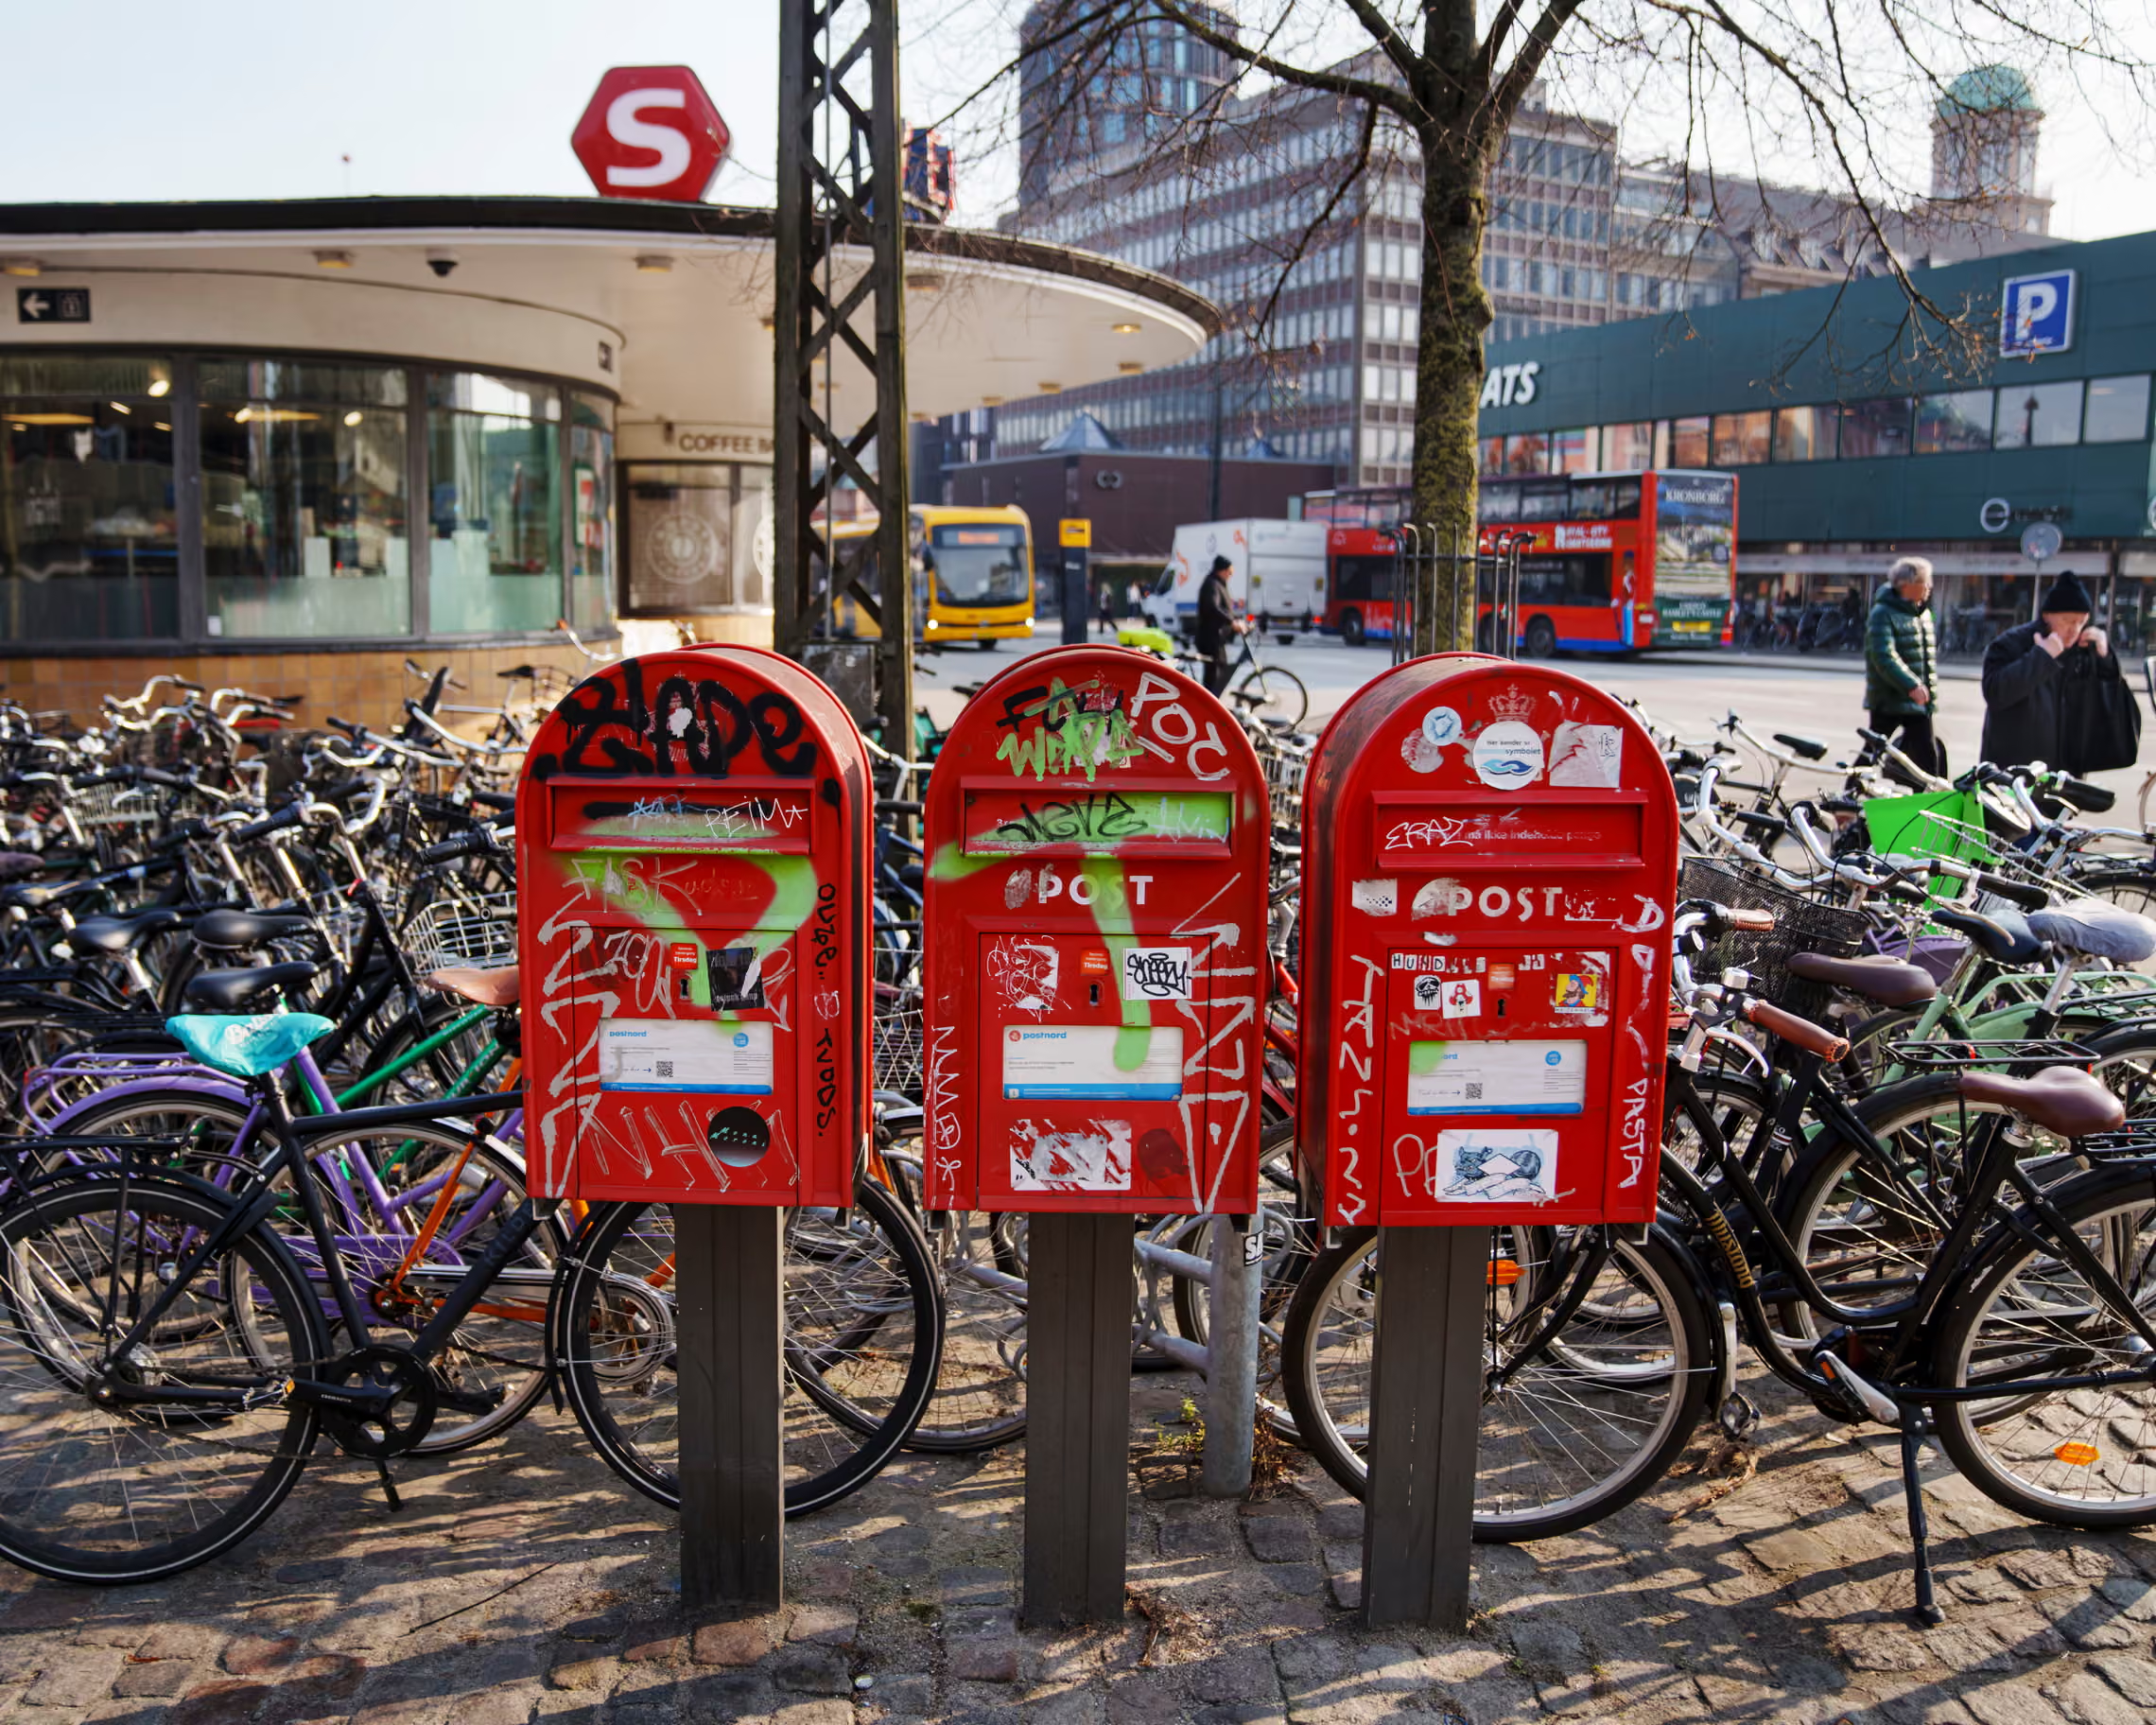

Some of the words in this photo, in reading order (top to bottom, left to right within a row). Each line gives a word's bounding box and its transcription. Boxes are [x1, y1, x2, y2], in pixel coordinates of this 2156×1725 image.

[606, 87, 691, 187] S
[2015, 283, 2058, 340] P
[679, 433, 755, 453] COFFEE
[1038, 875, 1154, 905] POST
[1447, 885, 1563, 922] POST
